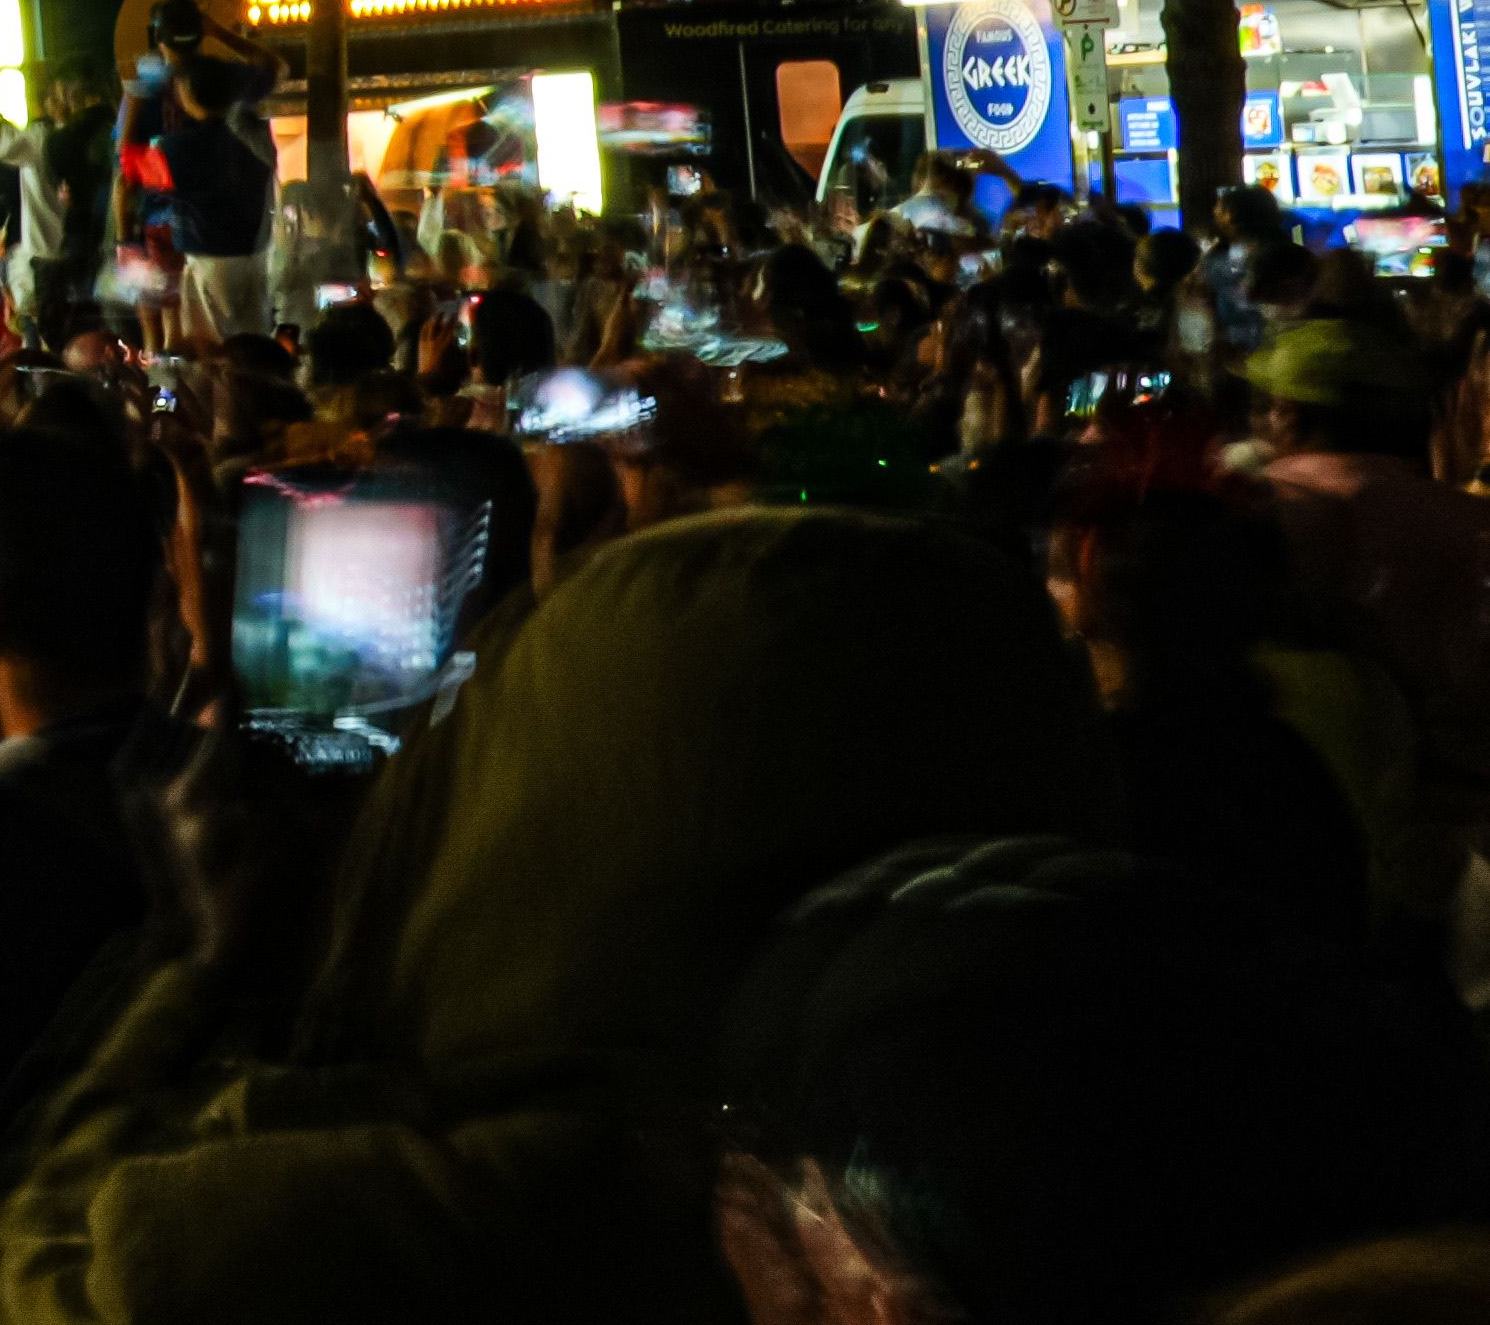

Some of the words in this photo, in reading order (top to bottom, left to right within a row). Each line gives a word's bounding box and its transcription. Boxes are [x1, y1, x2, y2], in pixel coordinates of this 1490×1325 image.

[664, 19, 759, 38] Woodfired
[962, 55, 1031, 90] GREEK
[1460, 22, 1488, 141] SOUVLAKI
